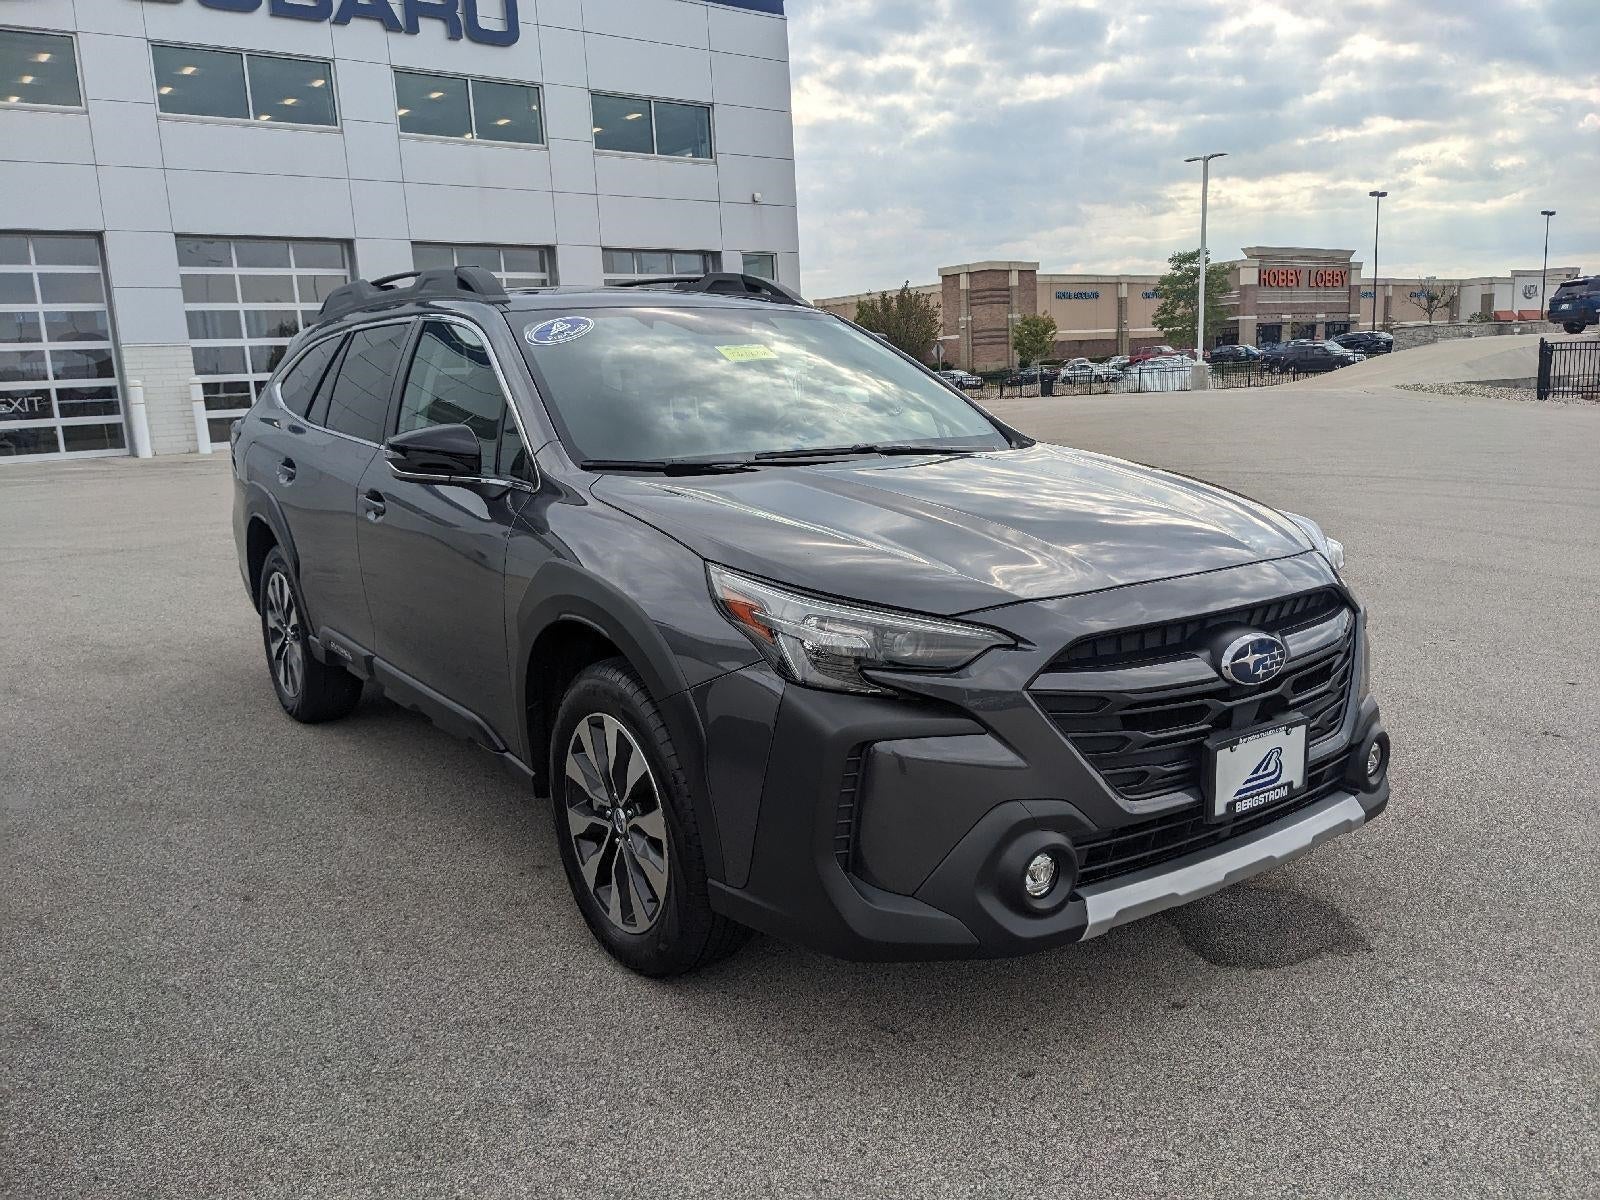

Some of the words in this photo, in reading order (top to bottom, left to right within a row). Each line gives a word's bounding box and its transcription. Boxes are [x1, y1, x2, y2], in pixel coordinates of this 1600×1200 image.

[1258, 268, 1302, 288] HOBBY
[1308, 269, 1348, 288] LOBBY
[1236, 785, 1288, 812] BERGSTROM
